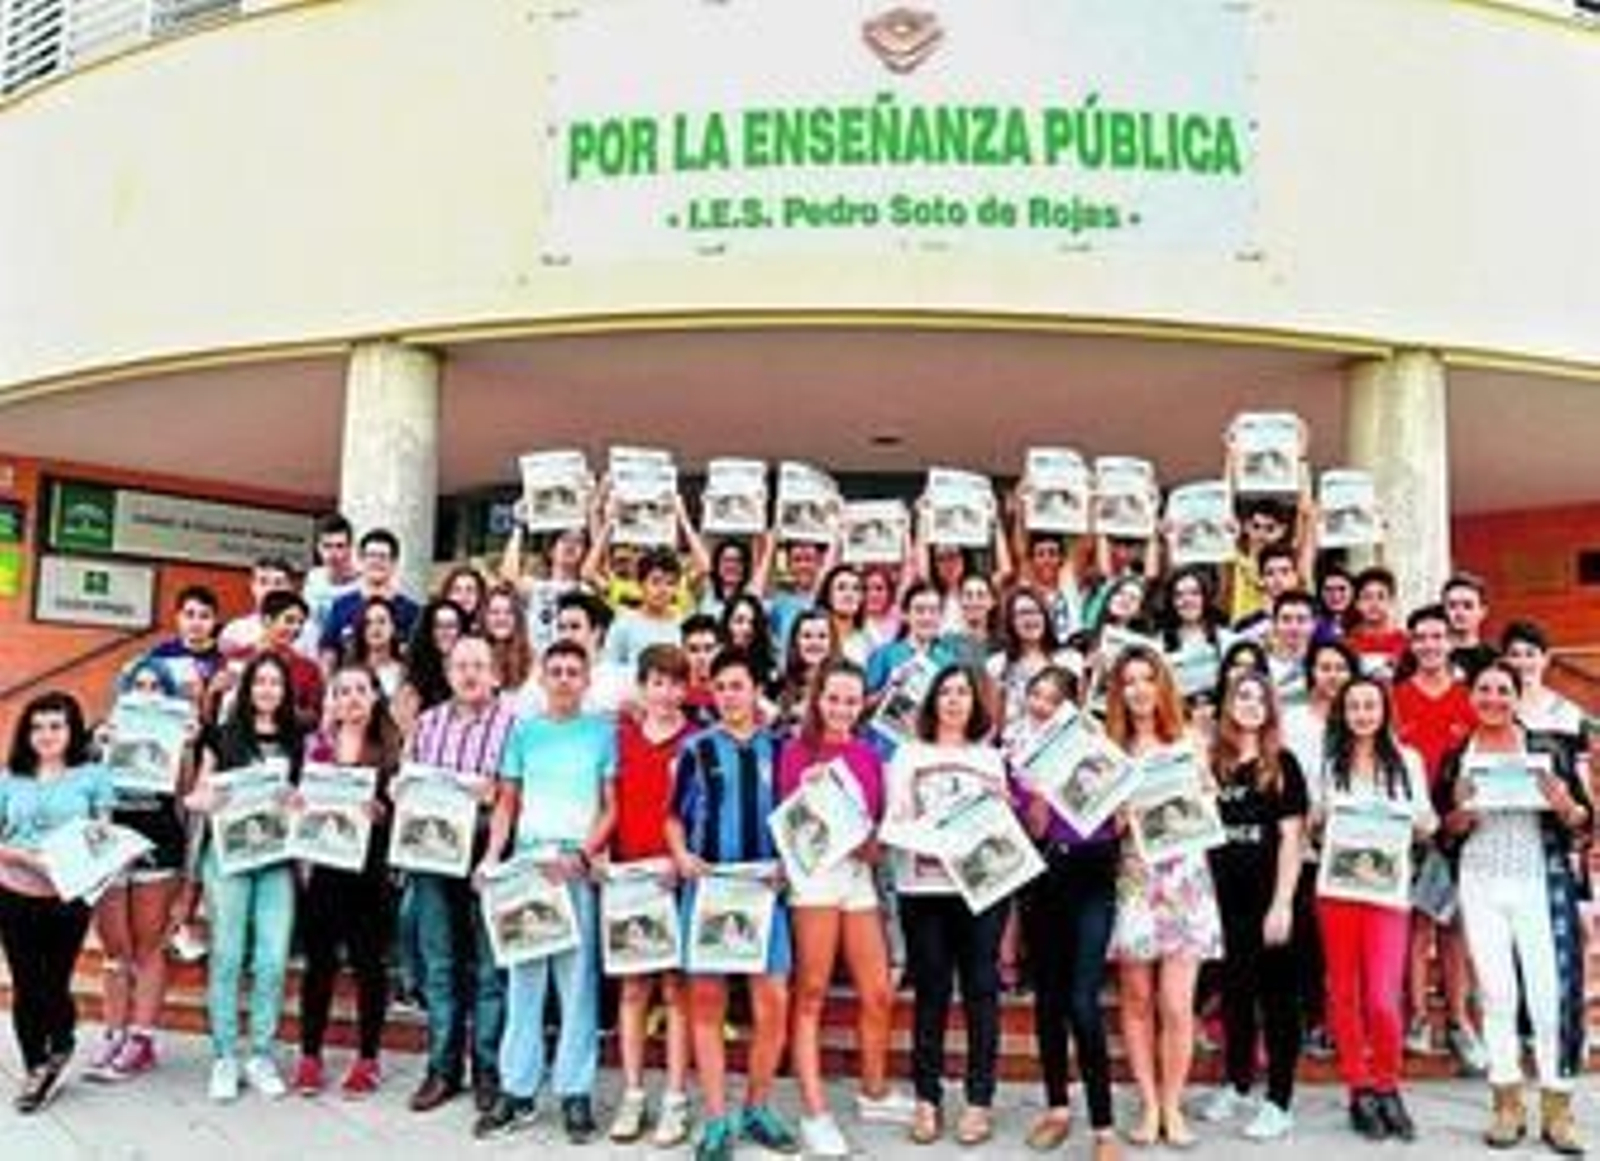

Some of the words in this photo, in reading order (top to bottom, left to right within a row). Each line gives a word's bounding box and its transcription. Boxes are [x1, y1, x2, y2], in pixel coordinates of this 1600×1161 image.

[569, 119, 658, 179] POR
[674, 112, 730, 170] LA
[743, 92, 1031, 167] ENSEÑANZA
[1043, 92, 1242, 175] PÚBLICA
[688, 199, 773, 228] I.E.S.
[783, 195, 880, 227] Pedro
[889, 194, 968, 226] Soto
[977, 198, 1016, 227] de
[1028, 198, 1122, 234] Rojas
